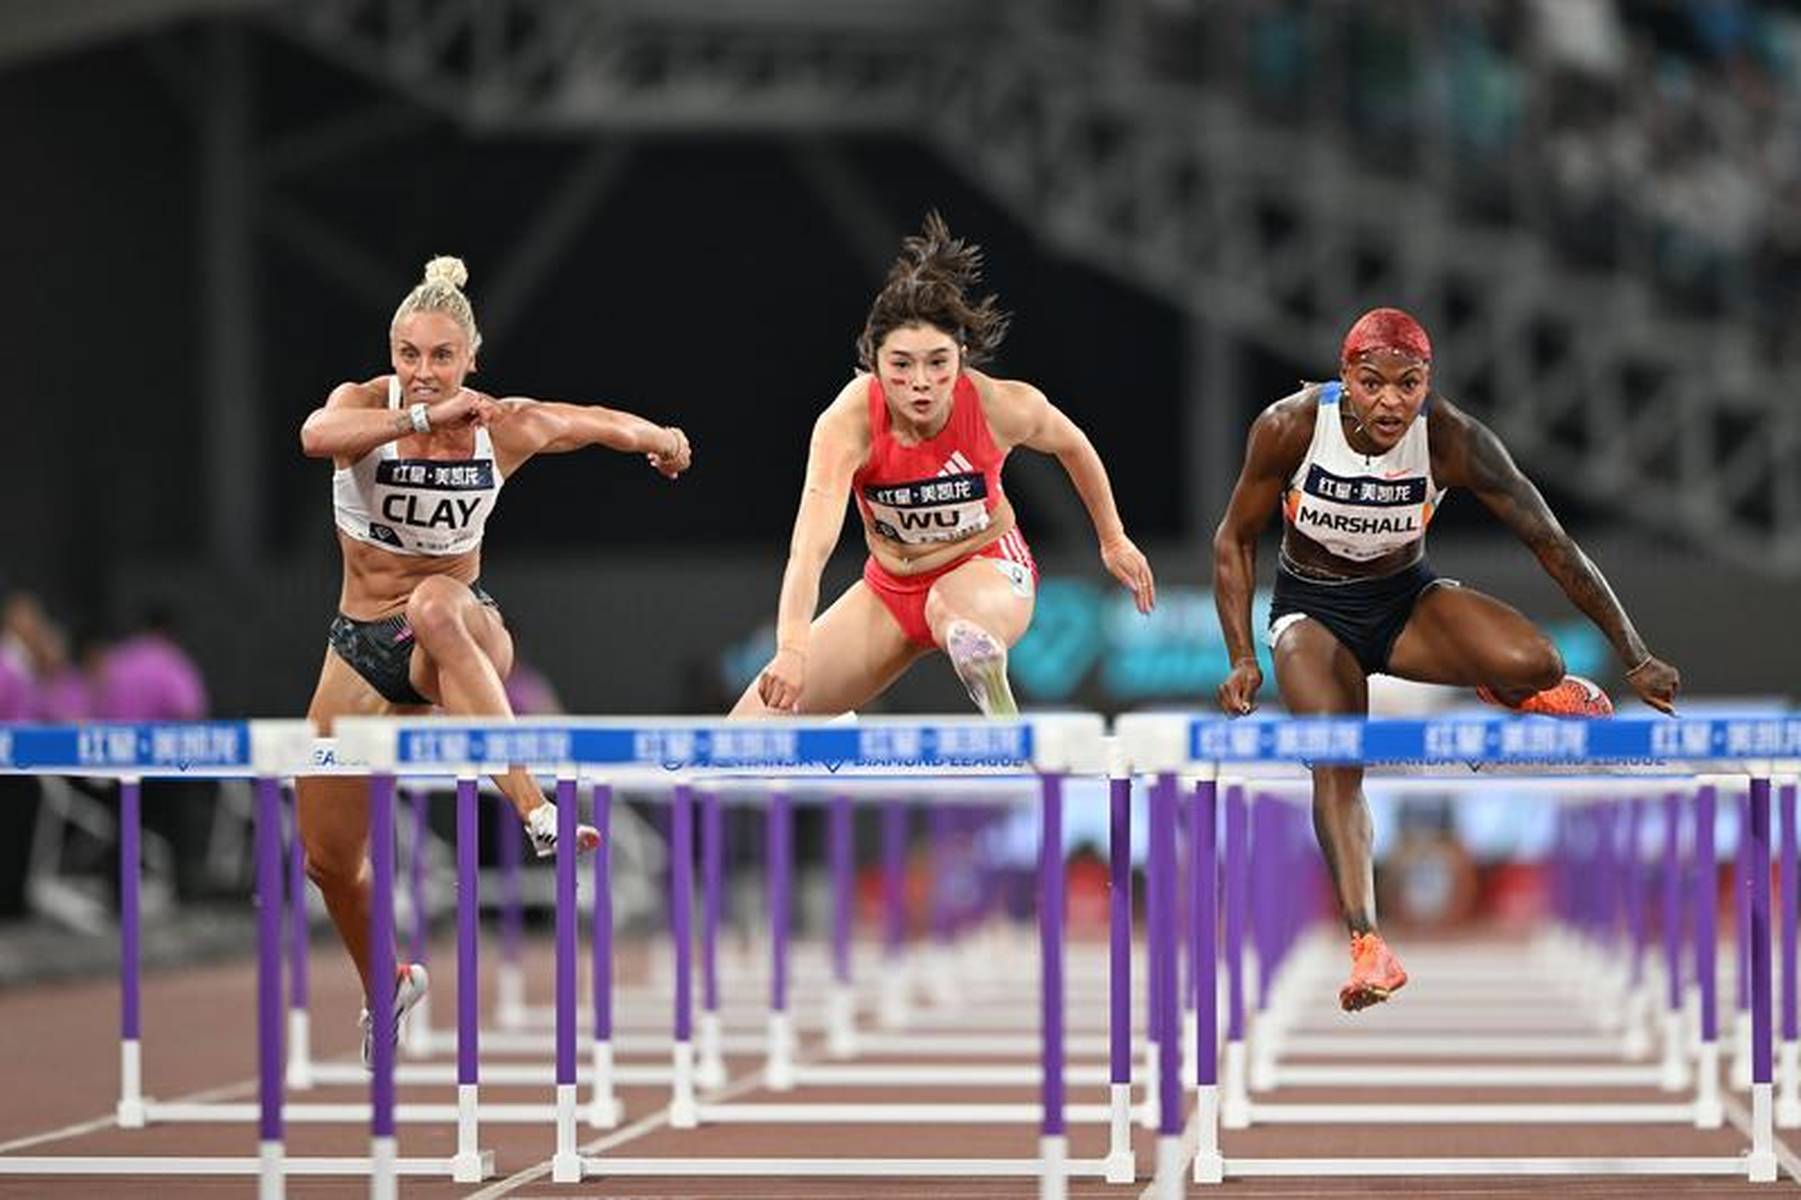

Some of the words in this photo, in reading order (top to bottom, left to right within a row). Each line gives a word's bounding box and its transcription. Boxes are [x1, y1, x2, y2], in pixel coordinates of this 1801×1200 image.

[382, 494, 481, 529] CLAY
[899, 510, 960, 530] WU
[1300, 507, 1417, 534] MARSHALL
